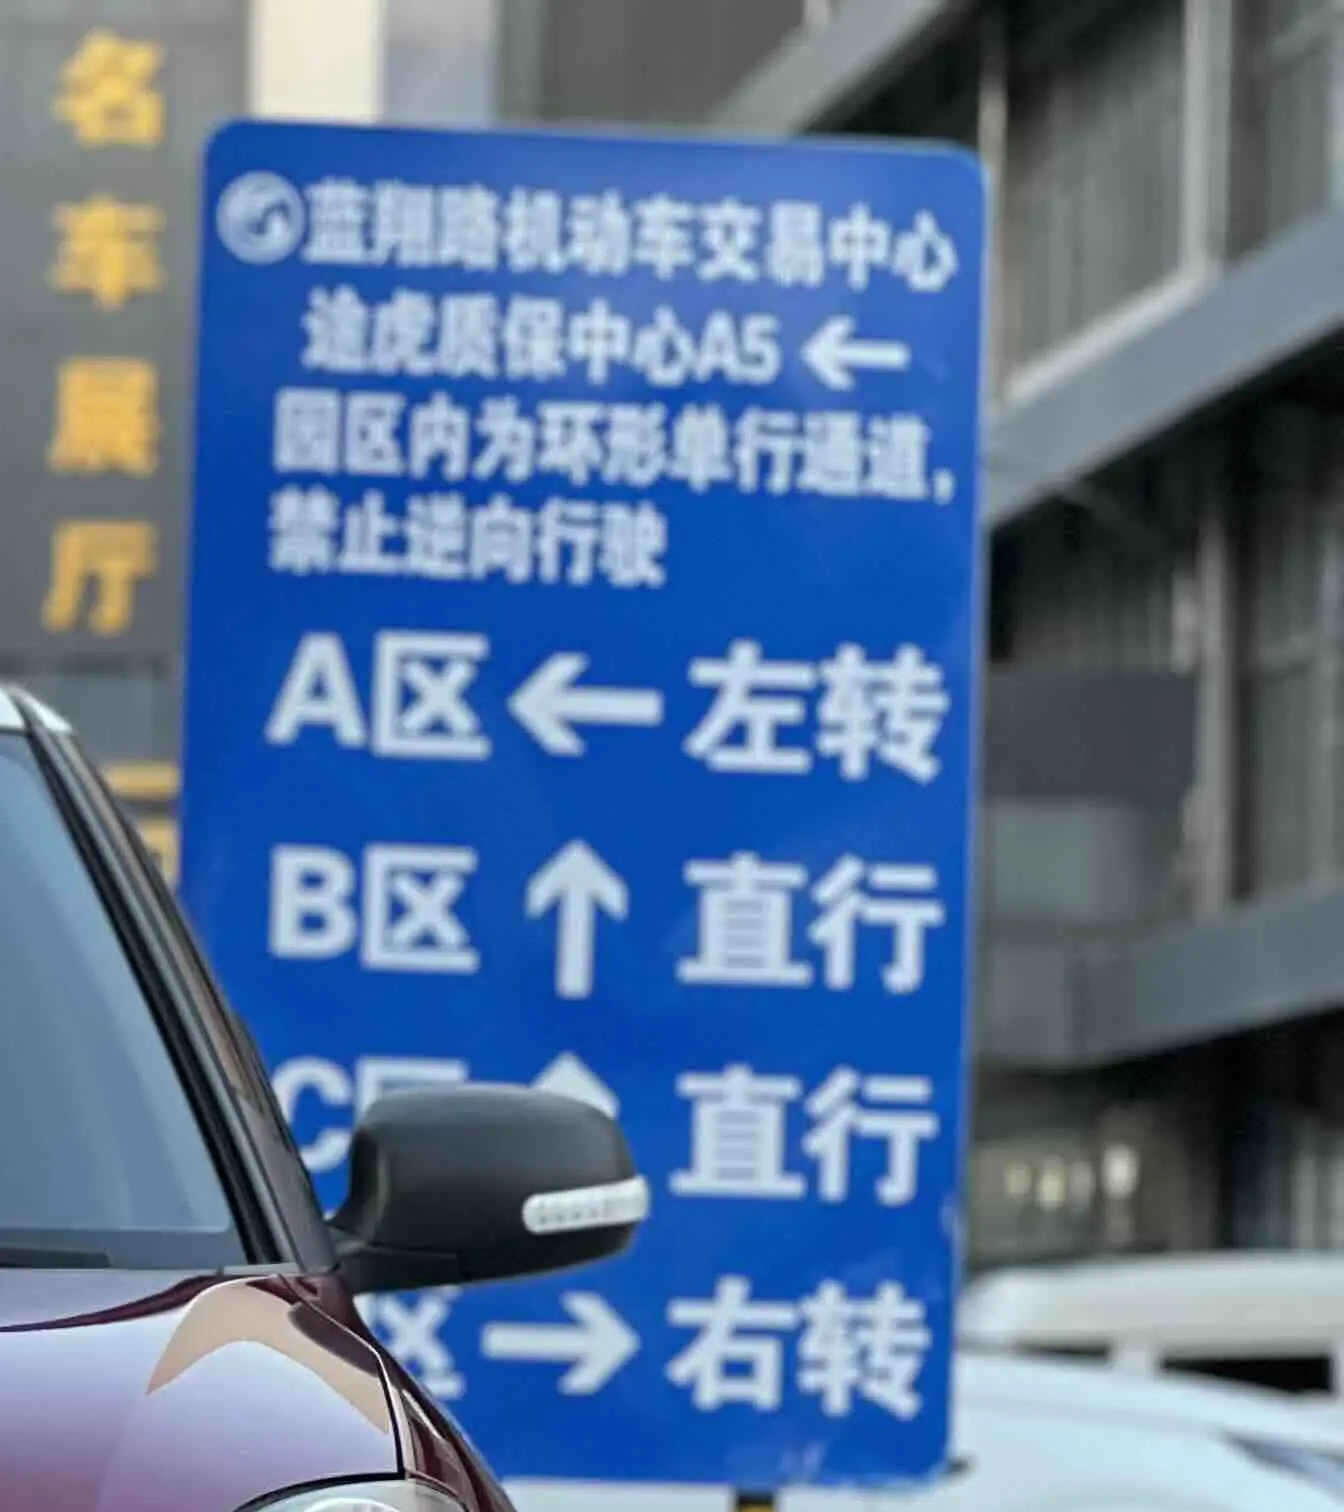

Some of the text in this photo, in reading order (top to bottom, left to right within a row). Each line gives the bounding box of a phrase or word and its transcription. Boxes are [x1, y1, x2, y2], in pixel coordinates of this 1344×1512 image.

[301, 178, 960, 294] 蓝翔路机动车交易中心
[40, 27, 169, 636] 名车展厅
[266, 485, 668, 588] 禁止逆向行驶
[264, 630, 952, 783] A区 左转
[266, 842, 946, 995] B区 直行
[668, 1063, 939, 1207] 直行
[664, 1275, 934, 1421] 右转
